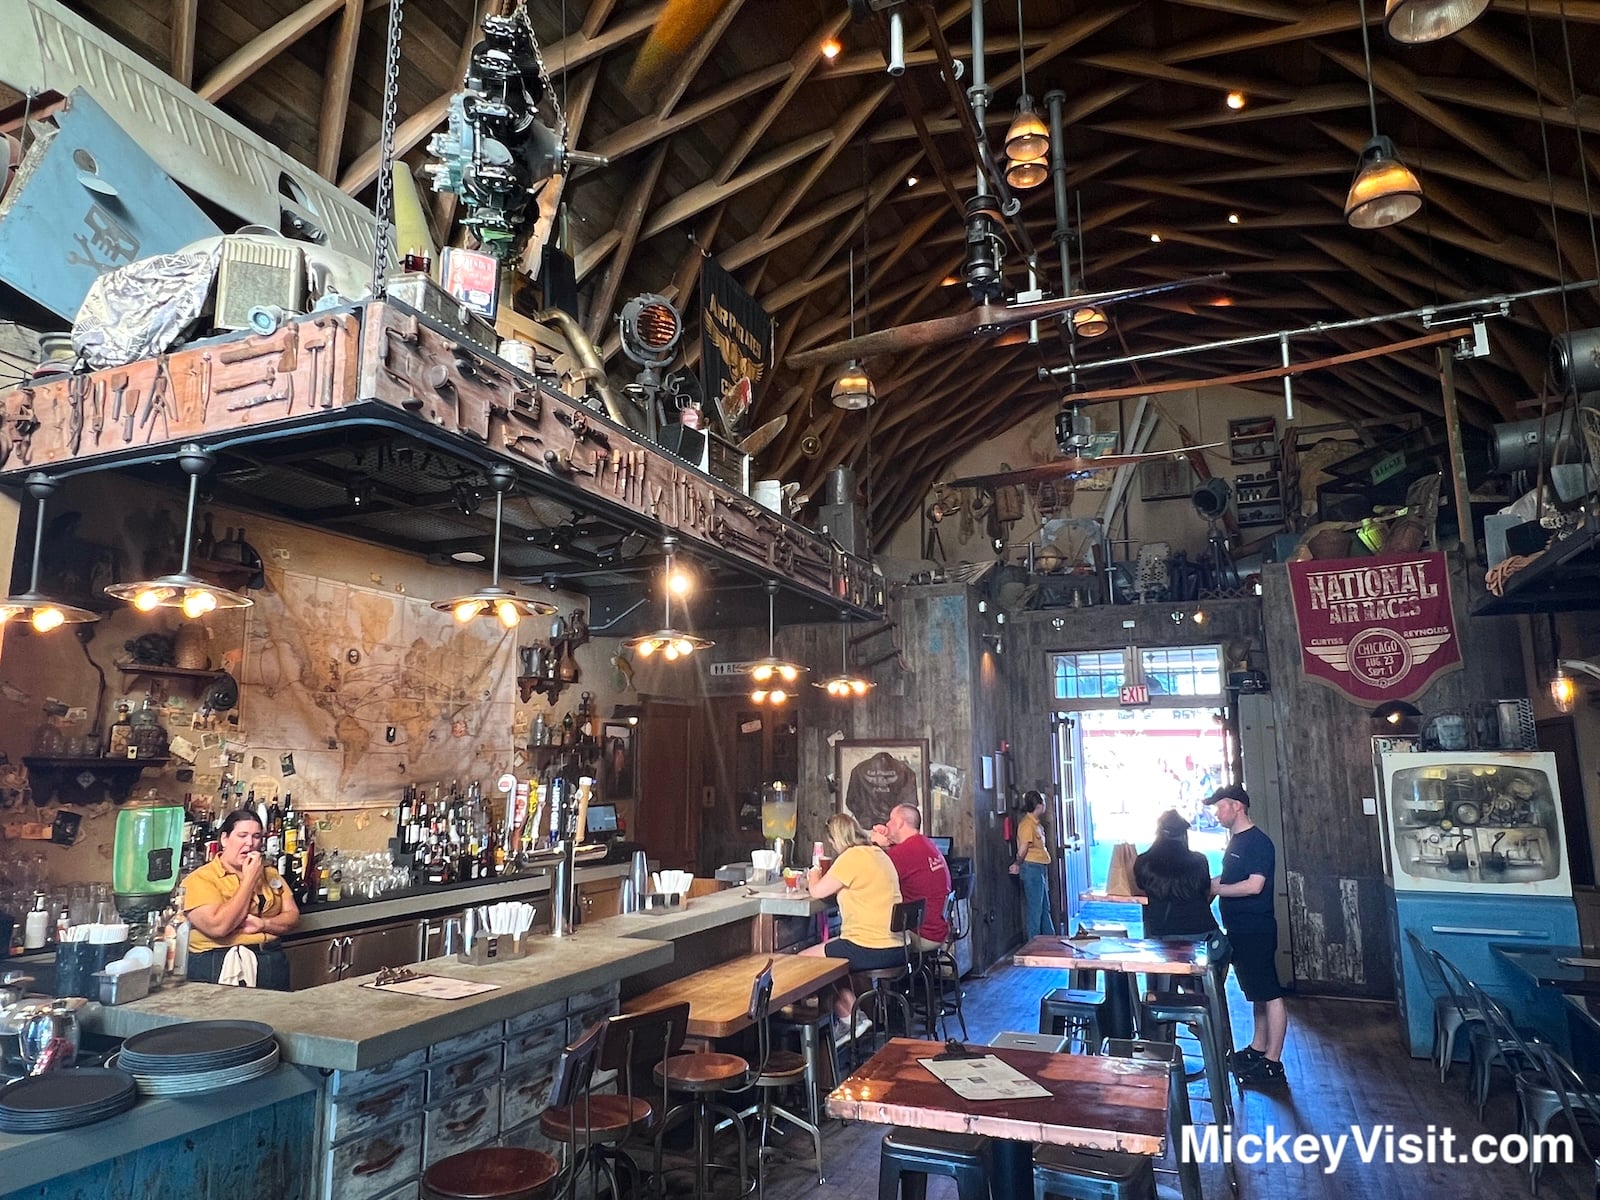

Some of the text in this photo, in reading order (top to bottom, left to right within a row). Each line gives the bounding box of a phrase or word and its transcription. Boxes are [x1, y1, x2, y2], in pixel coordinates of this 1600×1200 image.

[1306, 564, 1438, 610] NATIONAL
[1329, 596, 1421, 624] AIR RACES
[1403, 626, 1449, 638] REYNOLDS
[1311, 637, 1344, 646] CURTISS
[1357, 640, 1398, 655] CHICAGO
[1384, 656, 1394, 666] 23
[1121, 685, 1146, 702] EXIT
